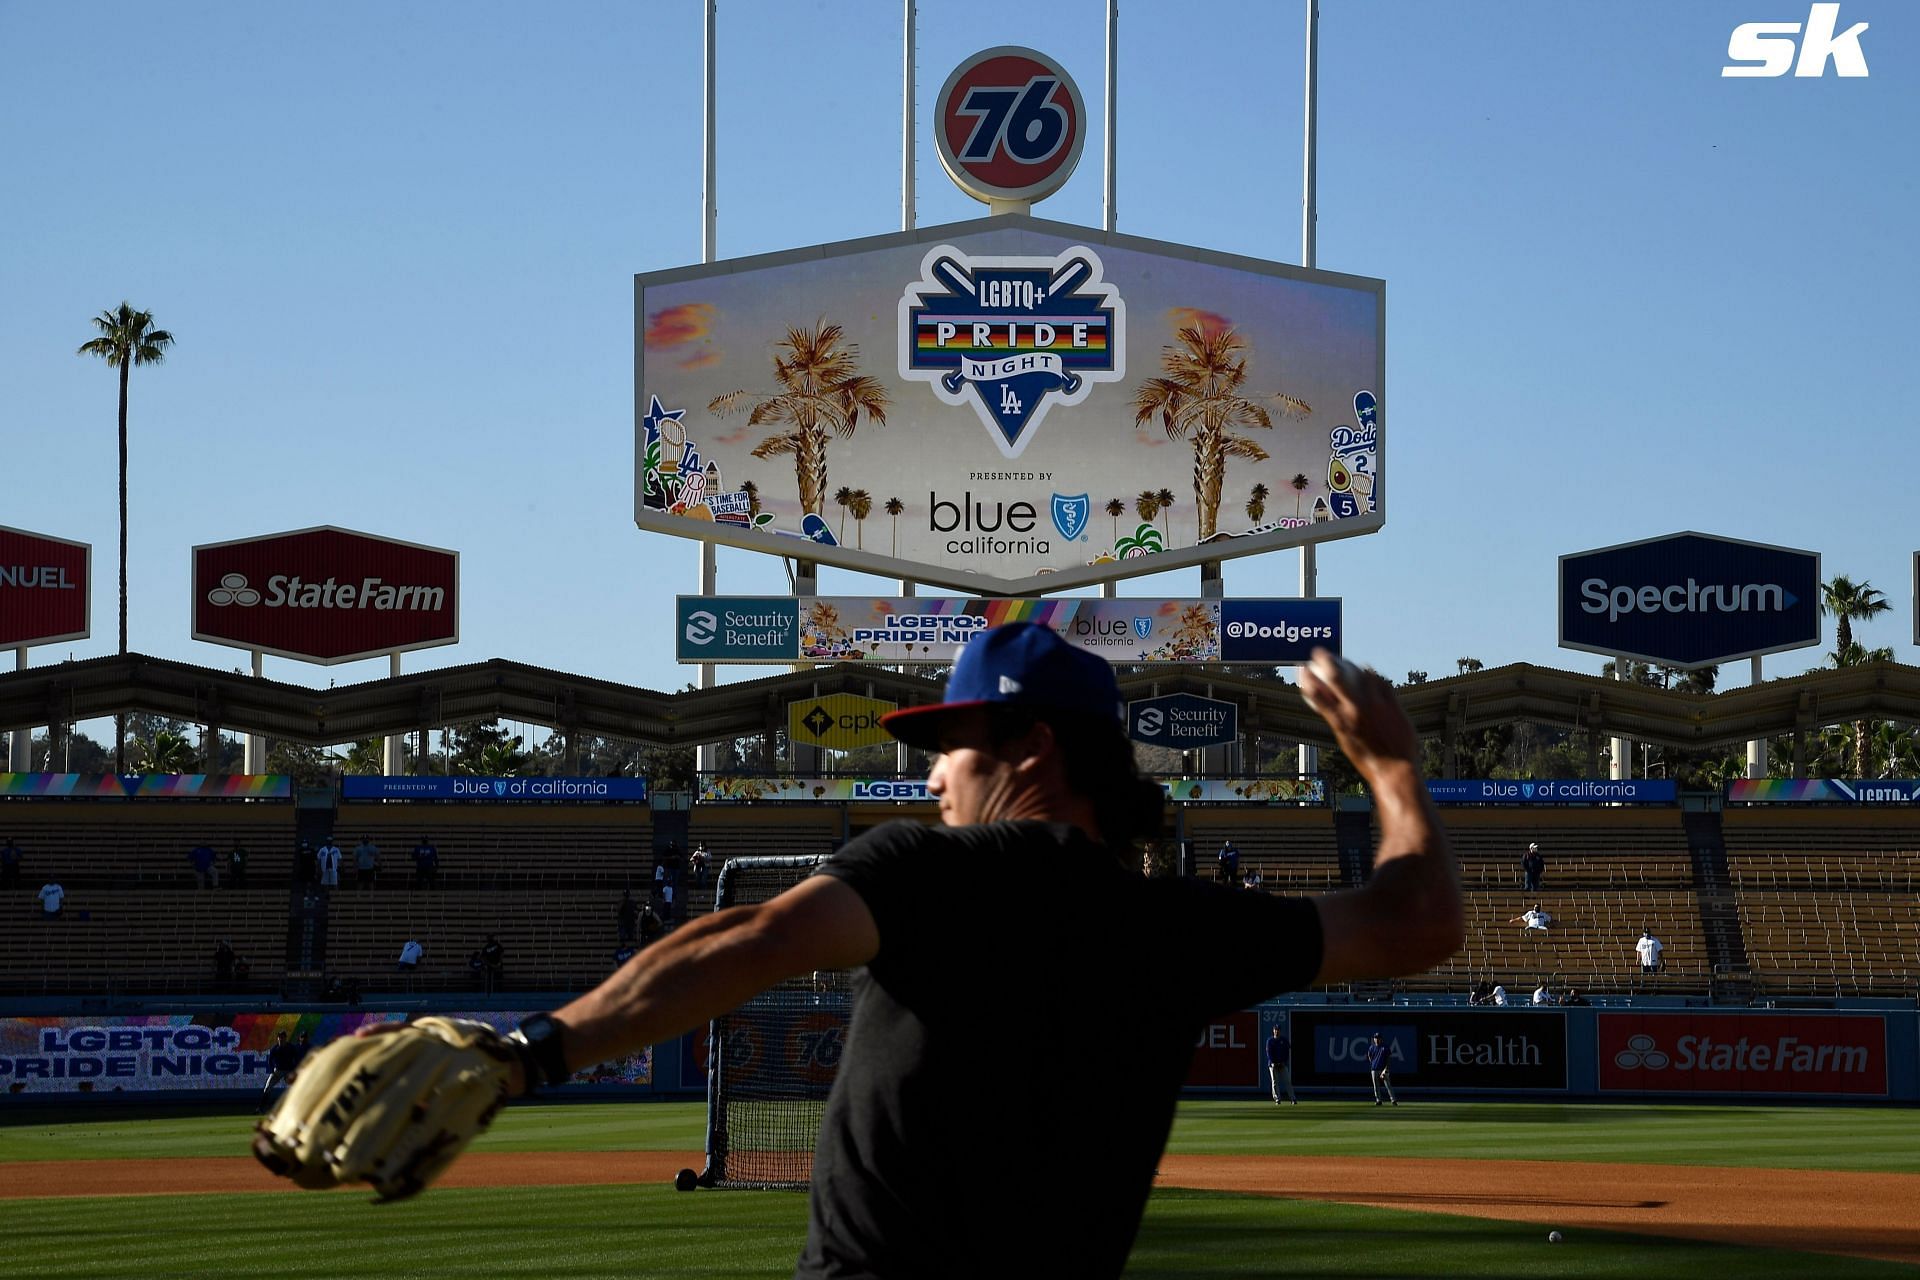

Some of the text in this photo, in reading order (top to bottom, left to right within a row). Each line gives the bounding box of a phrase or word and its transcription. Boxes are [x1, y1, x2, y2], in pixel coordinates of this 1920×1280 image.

[955, 75, 1062, 165] 76
[980, 280, 1046, 310] LGBTQ+
[936, 322, 1089, 348] PRIDE
[971, 355, 1054, 377] NIGHT
[1000, 384, 1022, 415] LA
[678, 441, 704, 478] LA
[969, 472, 1053, 481] PRESENTED BY
[714, 494, 733, 505] TIME
[734, 492, 748, 503] FOR
[1341, 500, 1352, 516] 5
[930, 491, 1037, 533] blue
[946, 537, 1050, 554] california
[0, 565, 76, 590] NUEL
[1581, 577, 1783, 623] Spectrum
[724, 611, 794, 628] Security
[886, 616, 987, 628] LGBTQ+
[1076, 616, 1128, 636] blue
[856, 630, 935, 642] PRIDE
[1084, 636, 1134, 647] california
[1226, 620, 1332, 643] @Dodgers
[1170, 707, 1227, 725] Security
[454, 779, 608, 795] blue of california
[855, 784, 938, 797] LGBT
[1482, 781, 1637, 797] blue of california
[1263, 1010, 1288, 1022] 375
[43, 1030, 237, 1051] LGBTQ+
[1328, 1037, 1405, 1062] UCA
[1427, 1034, 1543, 1066] Health
